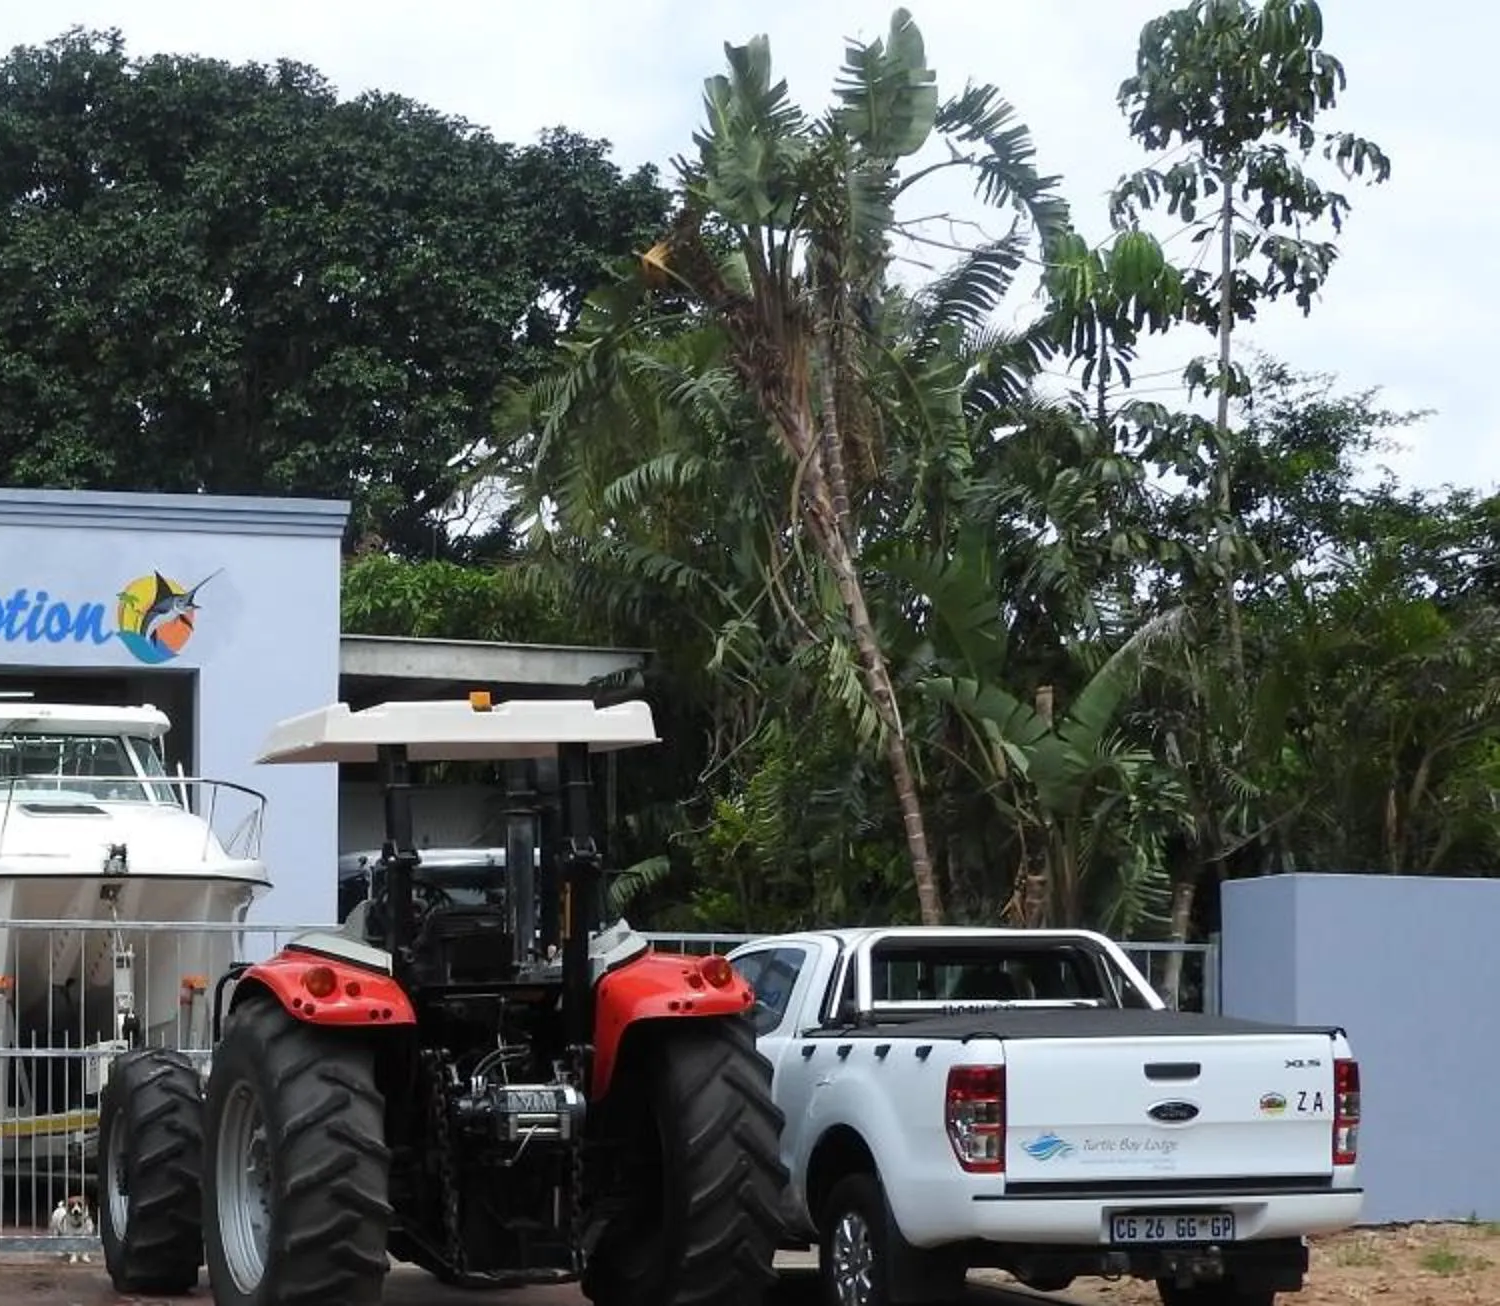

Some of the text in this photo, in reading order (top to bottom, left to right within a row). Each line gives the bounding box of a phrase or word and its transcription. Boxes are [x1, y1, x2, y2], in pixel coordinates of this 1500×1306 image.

[1116, 1216, 1231, 1239] CG 26 GG GP
